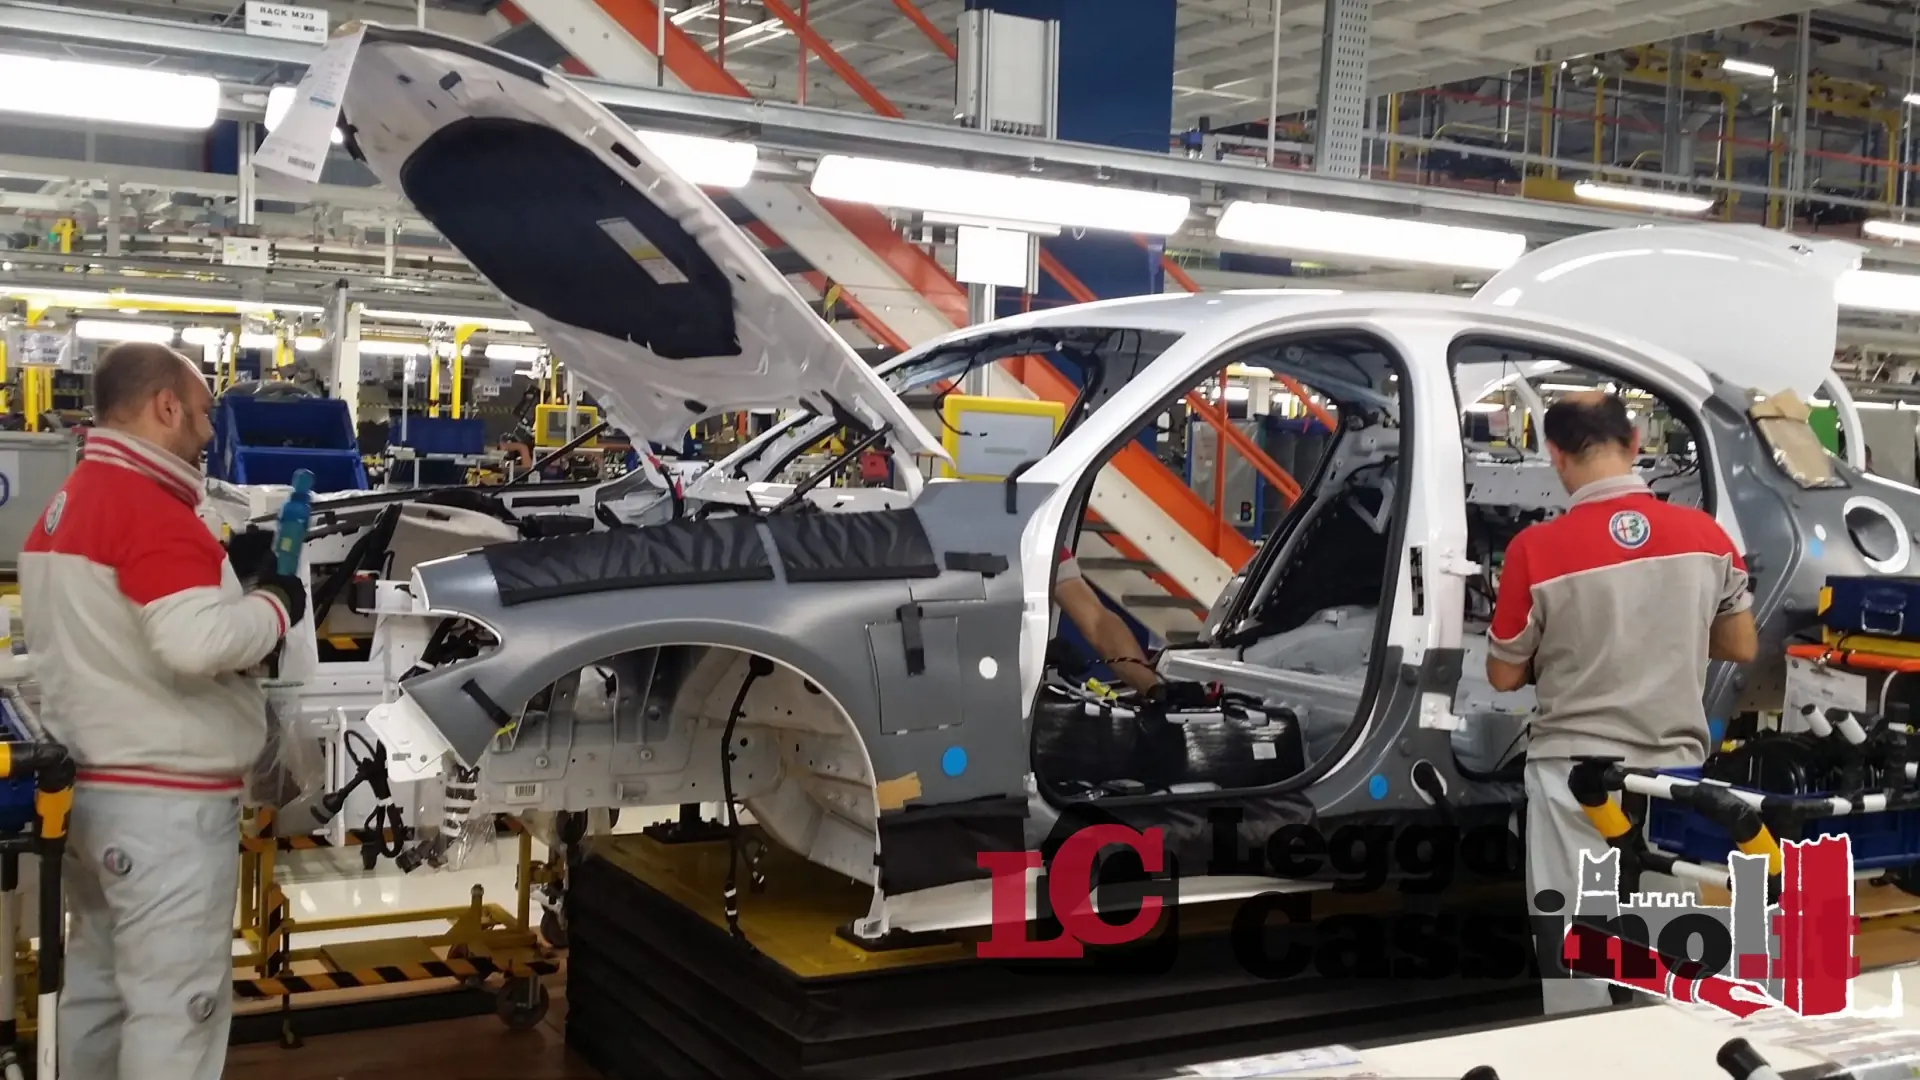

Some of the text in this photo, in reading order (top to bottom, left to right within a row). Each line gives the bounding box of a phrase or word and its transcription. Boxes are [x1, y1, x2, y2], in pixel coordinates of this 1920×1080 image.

[260, 6, 314, 20] RACK M2/3
[1240, 501, 1252, 521] B
